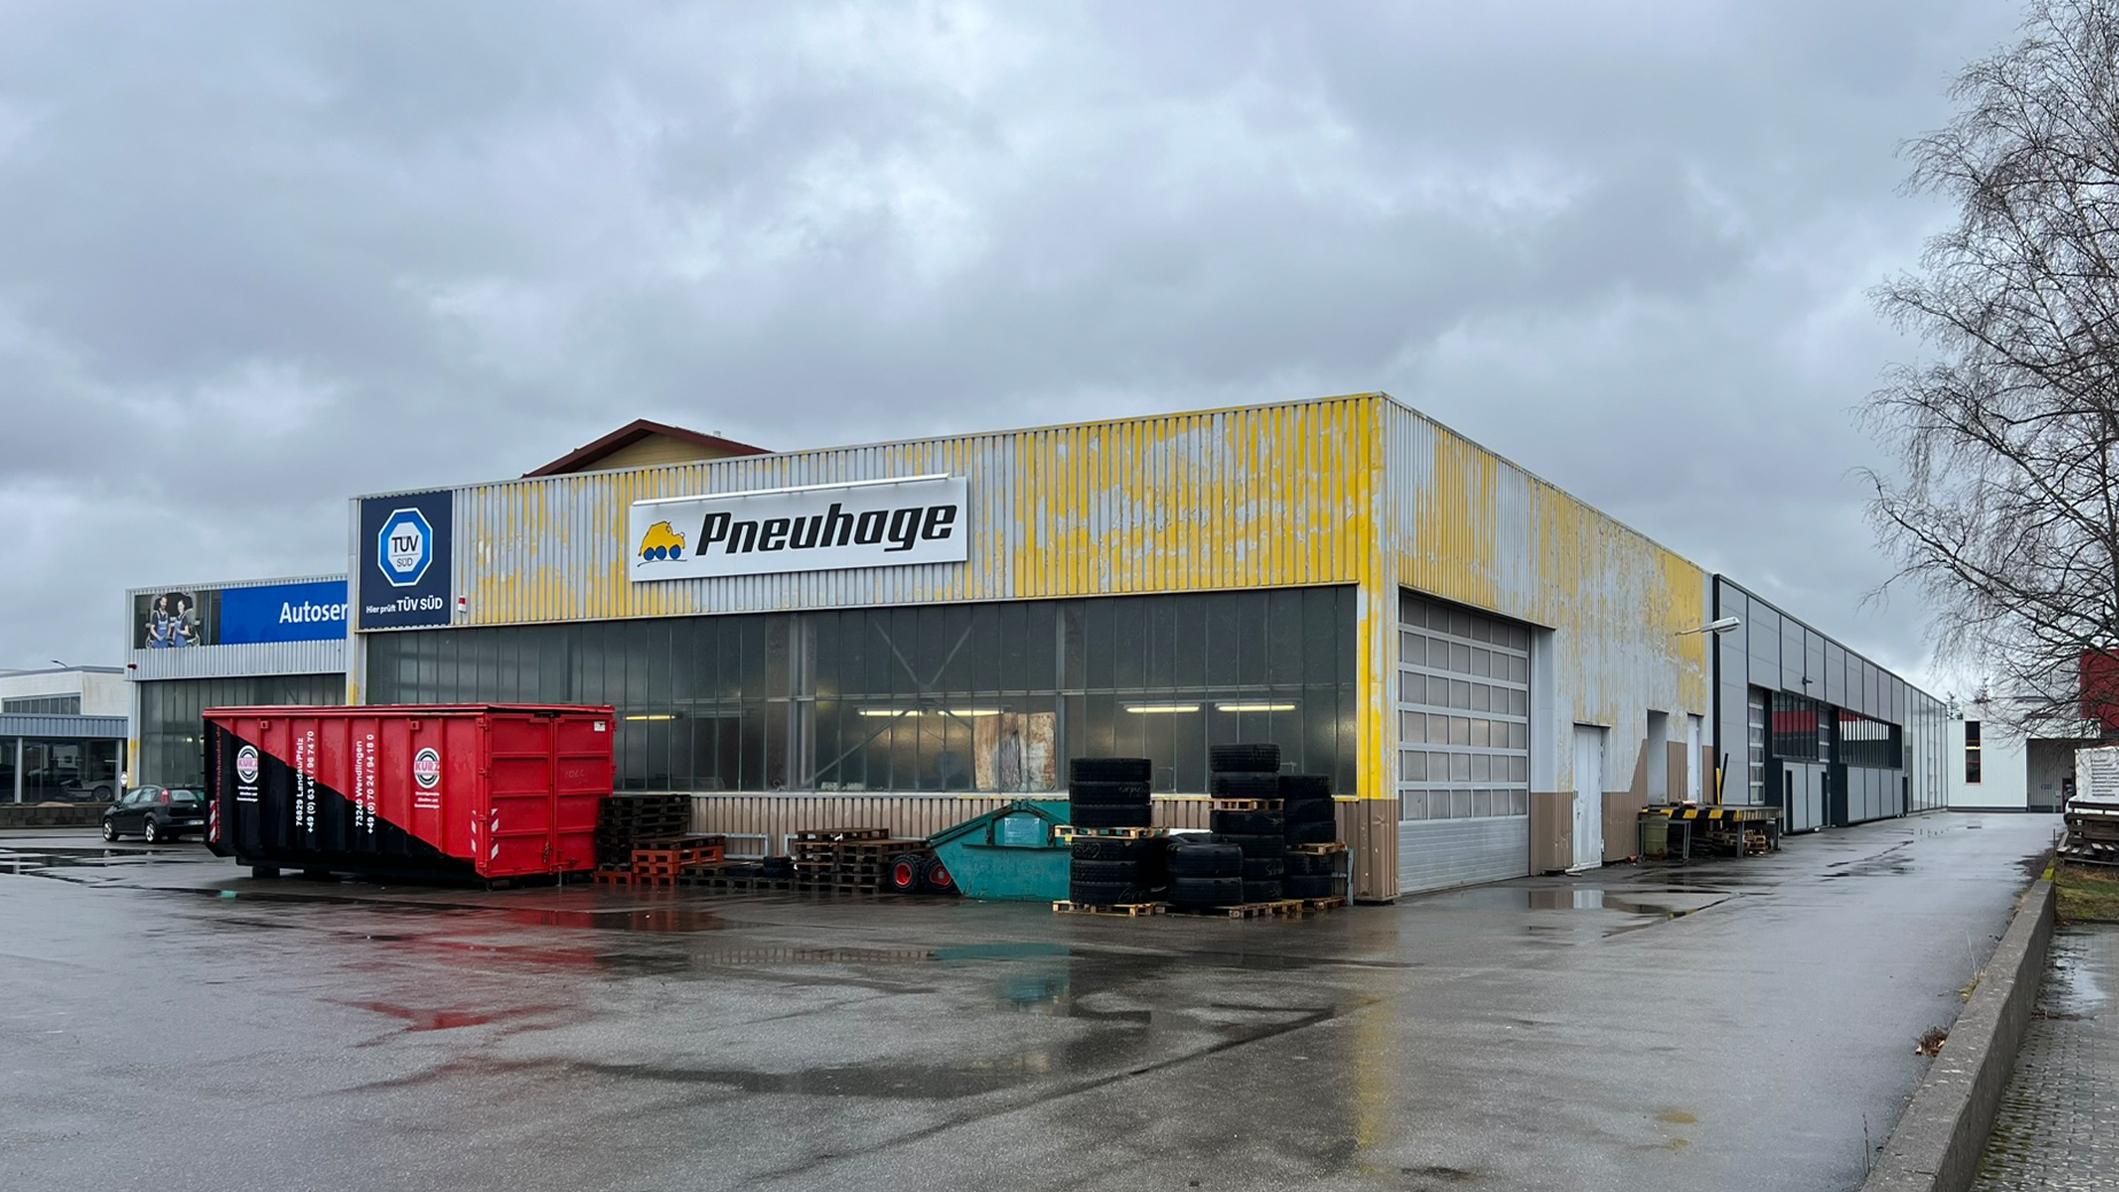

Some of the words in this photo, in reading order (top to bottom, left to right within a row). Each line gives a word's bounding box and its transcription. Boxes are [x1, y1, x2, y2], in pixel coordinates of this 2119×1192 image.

[695, 503, 957, 556] Pneuhage
[391, 535, 419, 553] TÜV
[397, 557, 413, 567] SÜD
[366, 605, 379, 614] Hier
[380, 604, 396, 615] prüft
[396, 596, 418, 612] TÜV
[420, 594, 443, 611] SÜD
[279, 600, 348, 624] Autoser
[307, 731, 314, 742] 70
[307, 744, 314, 755] 74
[296, 737, 304, 798] Landau/Pfalz
[367, 756, 374, 768] 94
[415, 760, 440, 772] KURZ
[355, 740, 364, 798] Wendlingen
[307, 776, 314, 787] 41
[366, 775, 374, 787] 24
[307, 788, 315, 800] 63
[367, 788, 375, 800] 70
[307, 801, 316, 815] (0)
[355, 798, 363, 827] 73240
[367, 802, 376, 815] (0)
